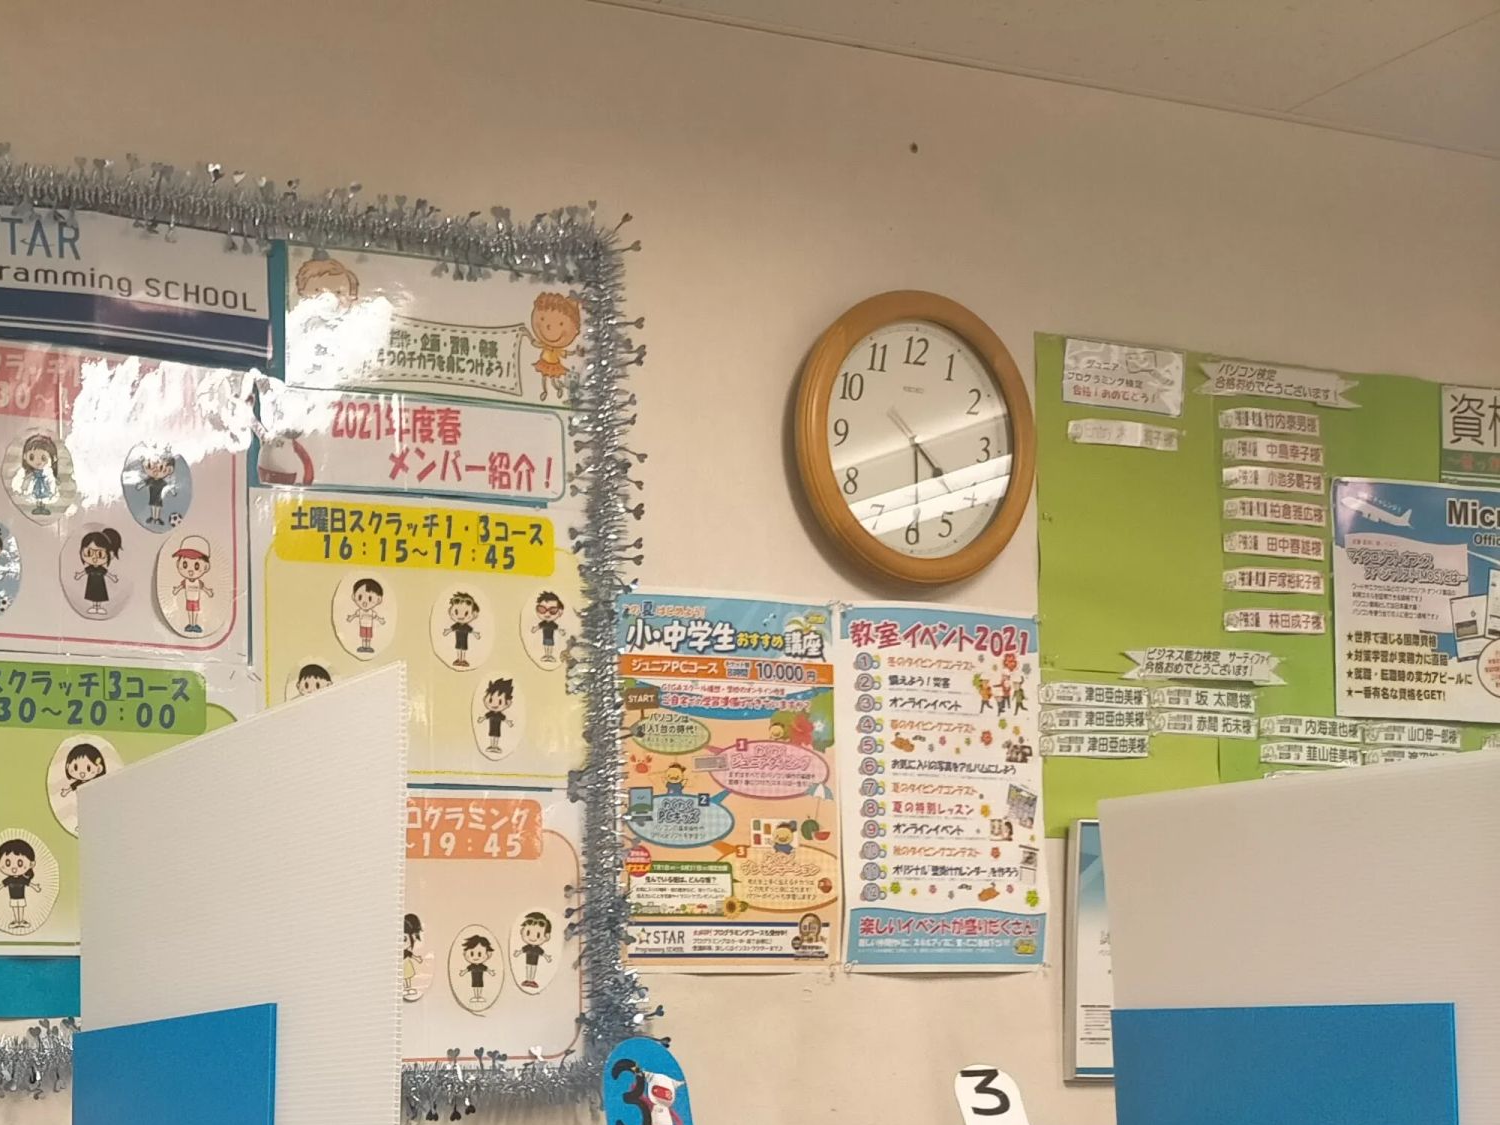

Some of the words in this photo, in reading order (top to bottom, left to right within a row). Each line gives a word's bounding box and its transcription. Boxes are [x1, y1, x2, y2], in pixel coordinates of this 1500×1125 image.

[144, 279, 257, 313] SCHOOL
[867, 342, 888, 373] 11
[902, 336, 930, 366] 12
[944, 353, 955, 382] 1
[839, 371, 864, 402] 10
[965, 388, 982, 416] 2
[833, 418, 849, 447] 9
[975, 436, 991, 464] 3
[388, 448, 554, 492] メンバー紹介!
[842, 466, 859, 495] 8
[290, 506, 544, 546] 土曜日スクラッチ1・3コース
[938, 511, 954, 538] 5
[1448, 499, 1500, 527] Mic
[904, 515, 920, 545] 6
[850, 620, 1030, 657] 教室イベント2021
[628, 694, 655, 703] START
[653, 930, 685, 945] STAR
[959, 1068, 1011, 1116] 3
